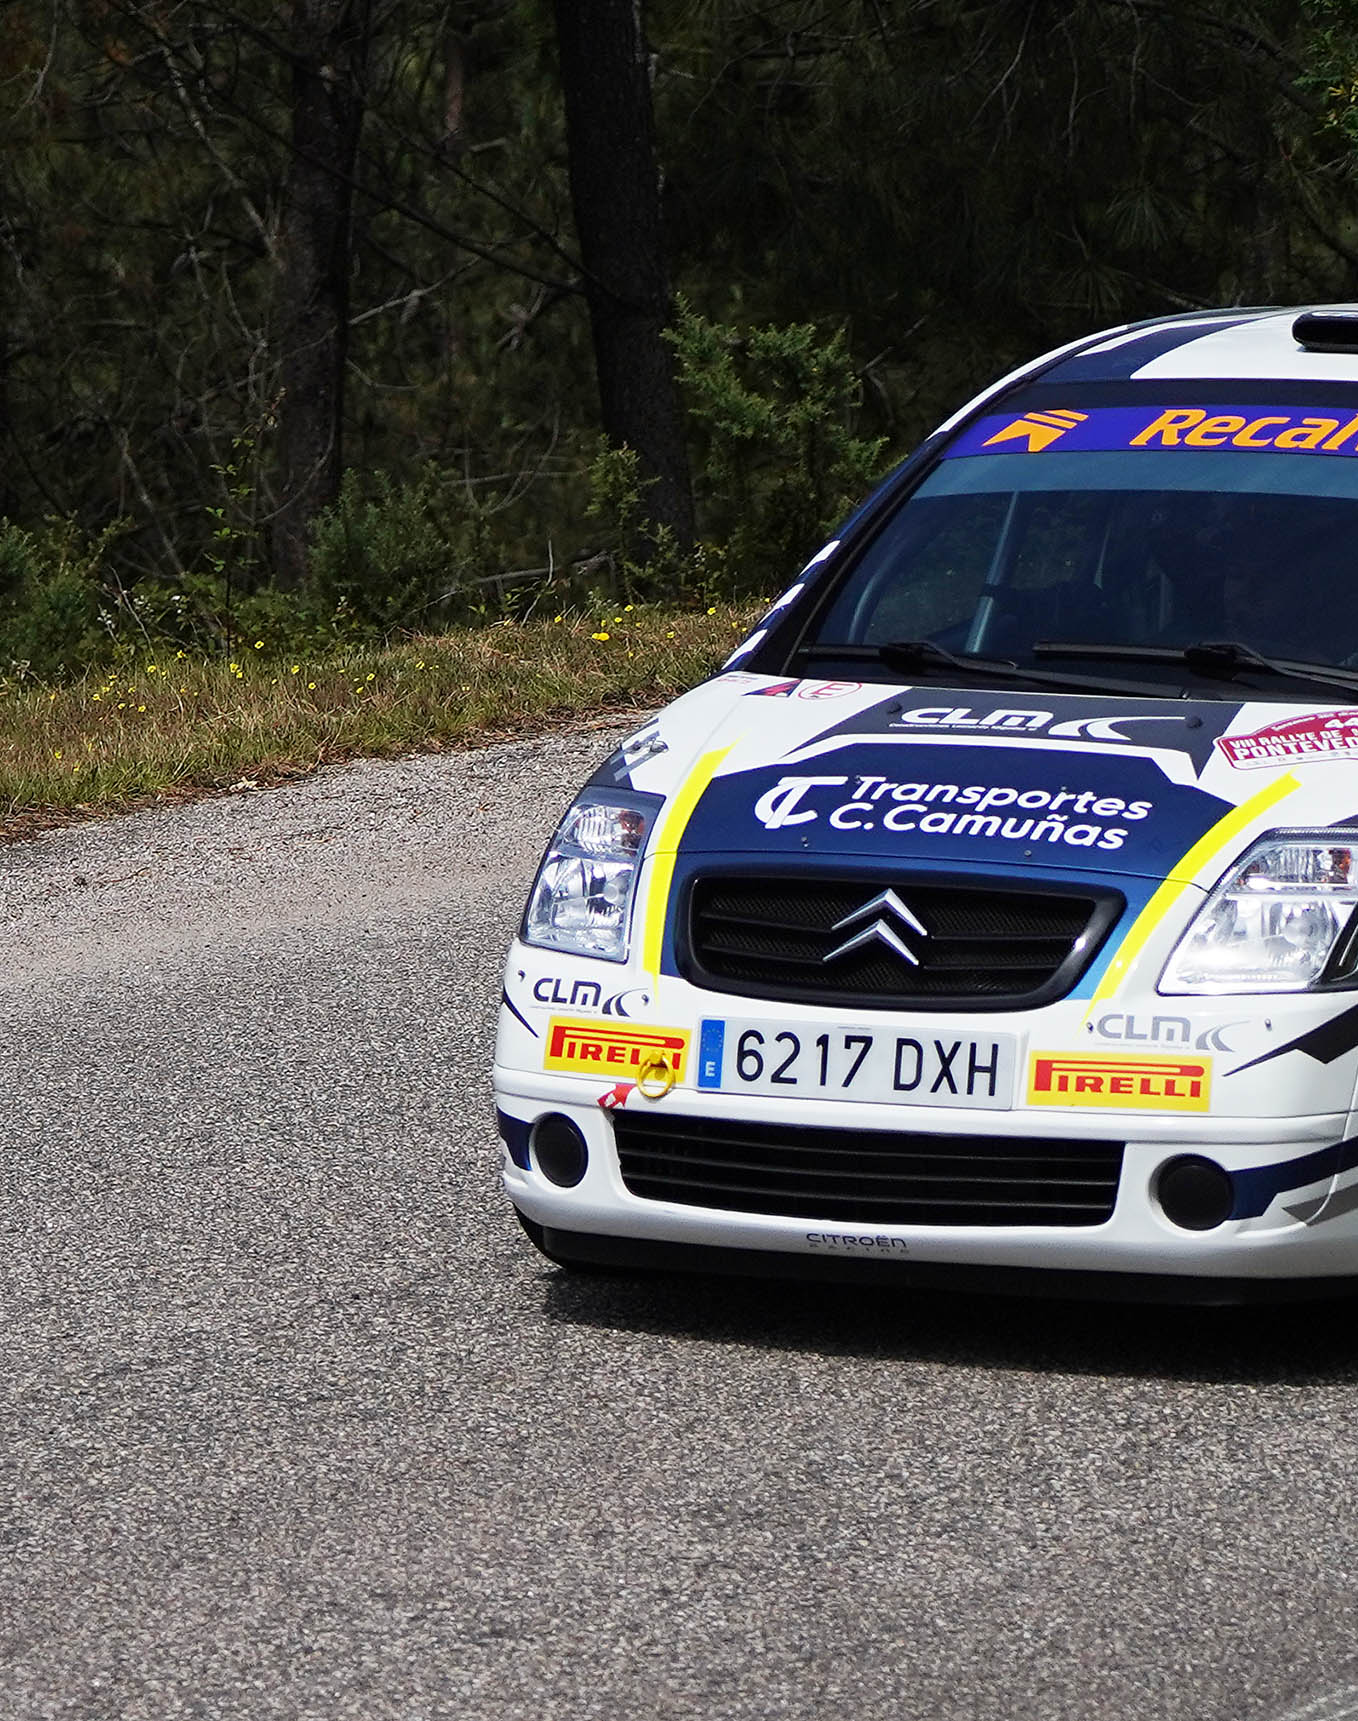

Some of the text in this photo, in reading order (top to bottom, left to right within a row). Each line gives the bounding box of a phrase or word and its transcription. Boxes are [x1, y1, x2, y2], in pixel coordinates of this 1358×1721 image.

[900, 707, 1054, 728] CLM
[1228, 739, 1259, 750] VIII
[1259, 732, 1318, 745] RALLYE
[1320, 729, 1343, 740] DE
[851, 775, 1153, 821] Transportes
[533, 977, 602, 1008] CLM
[1097, 1014, 1192, 1044] CLM
[549, 1025, 687, 1071] PIRELI
[737, 1029, 999, 1097] 6217 DXH
[704, 1060, 716, 1078] E
[1034, 1058, 1205, 1098] PIRELLI
[806, 1232, 908, 1248] CITROËN
